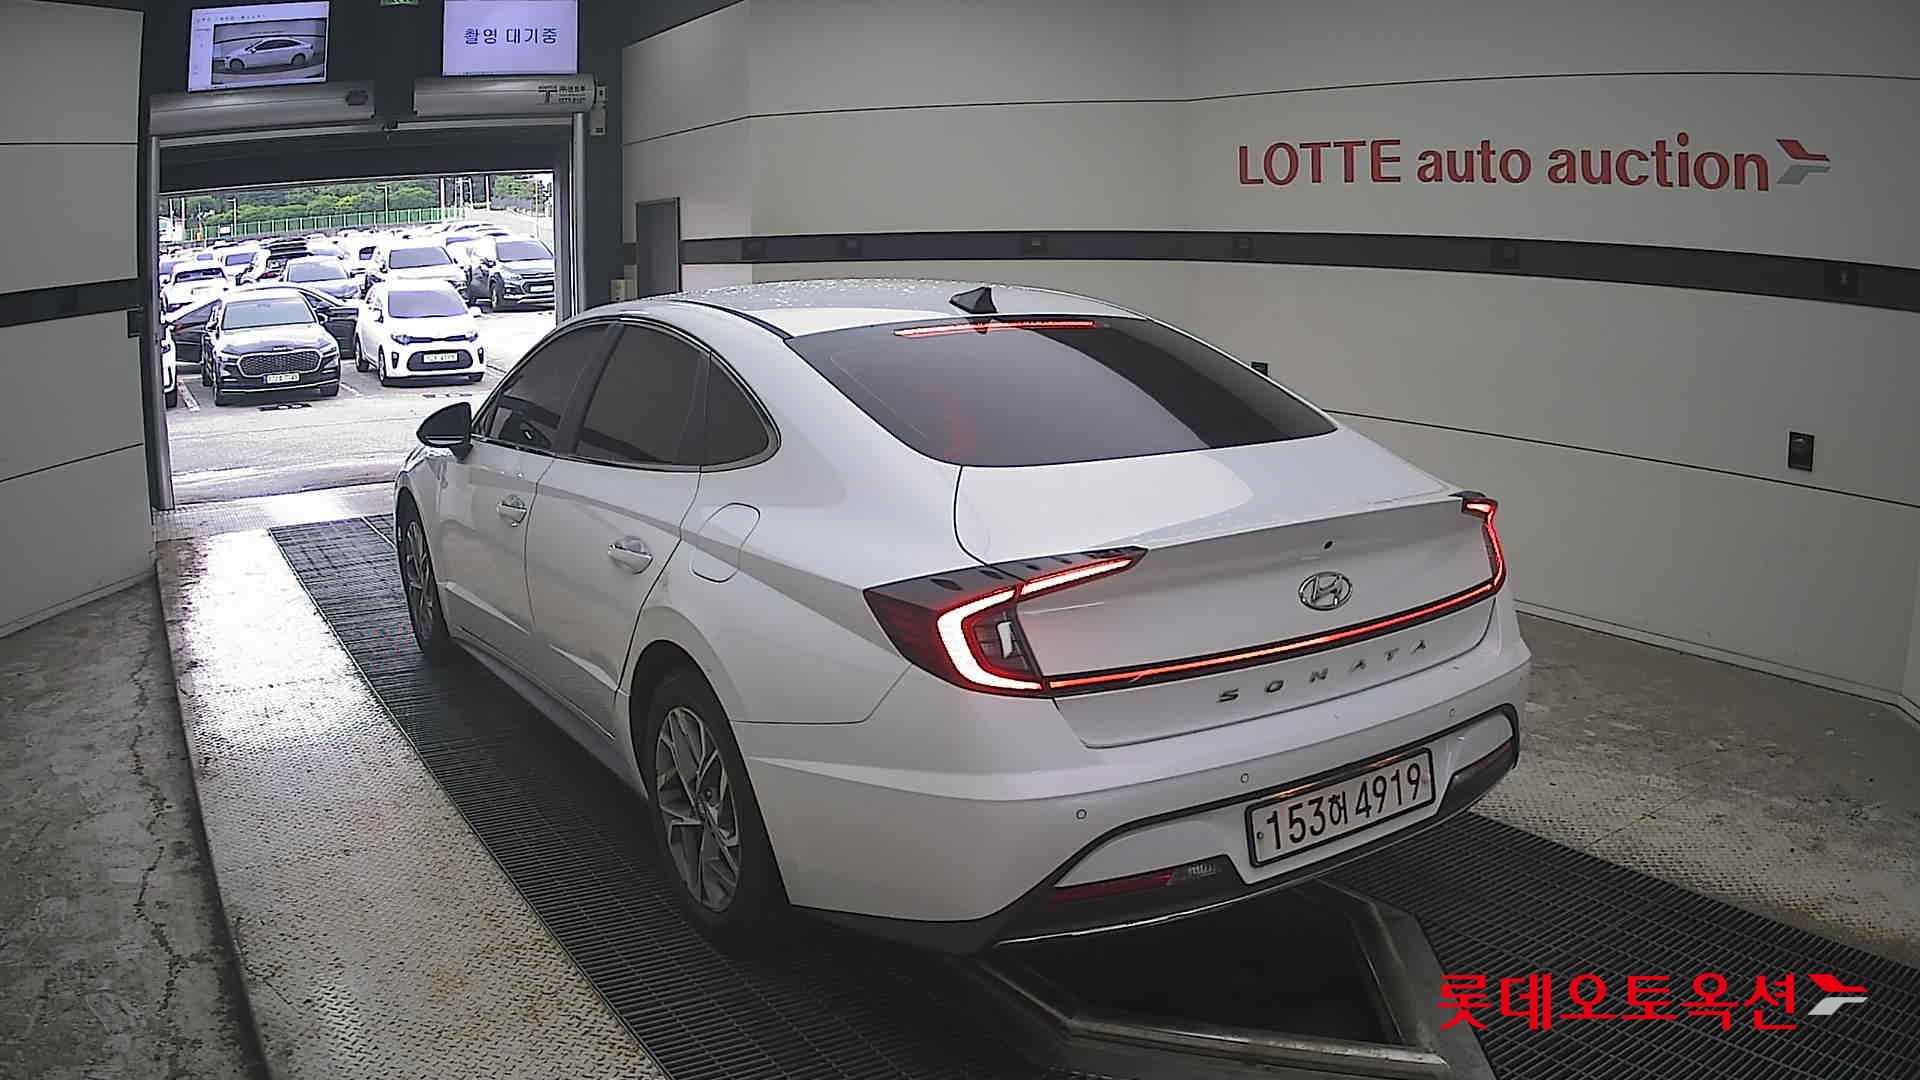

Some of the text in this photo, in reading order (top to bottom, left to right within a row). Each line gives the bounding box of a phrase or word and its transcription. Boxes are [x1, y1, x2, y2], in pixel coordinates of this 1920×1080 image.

[465, 27, 558, 45] 촬영 대기중
[1239, 132, 1769, 191] LOTTE auto auction
[1218, 640, 1427, 703] SONATA
